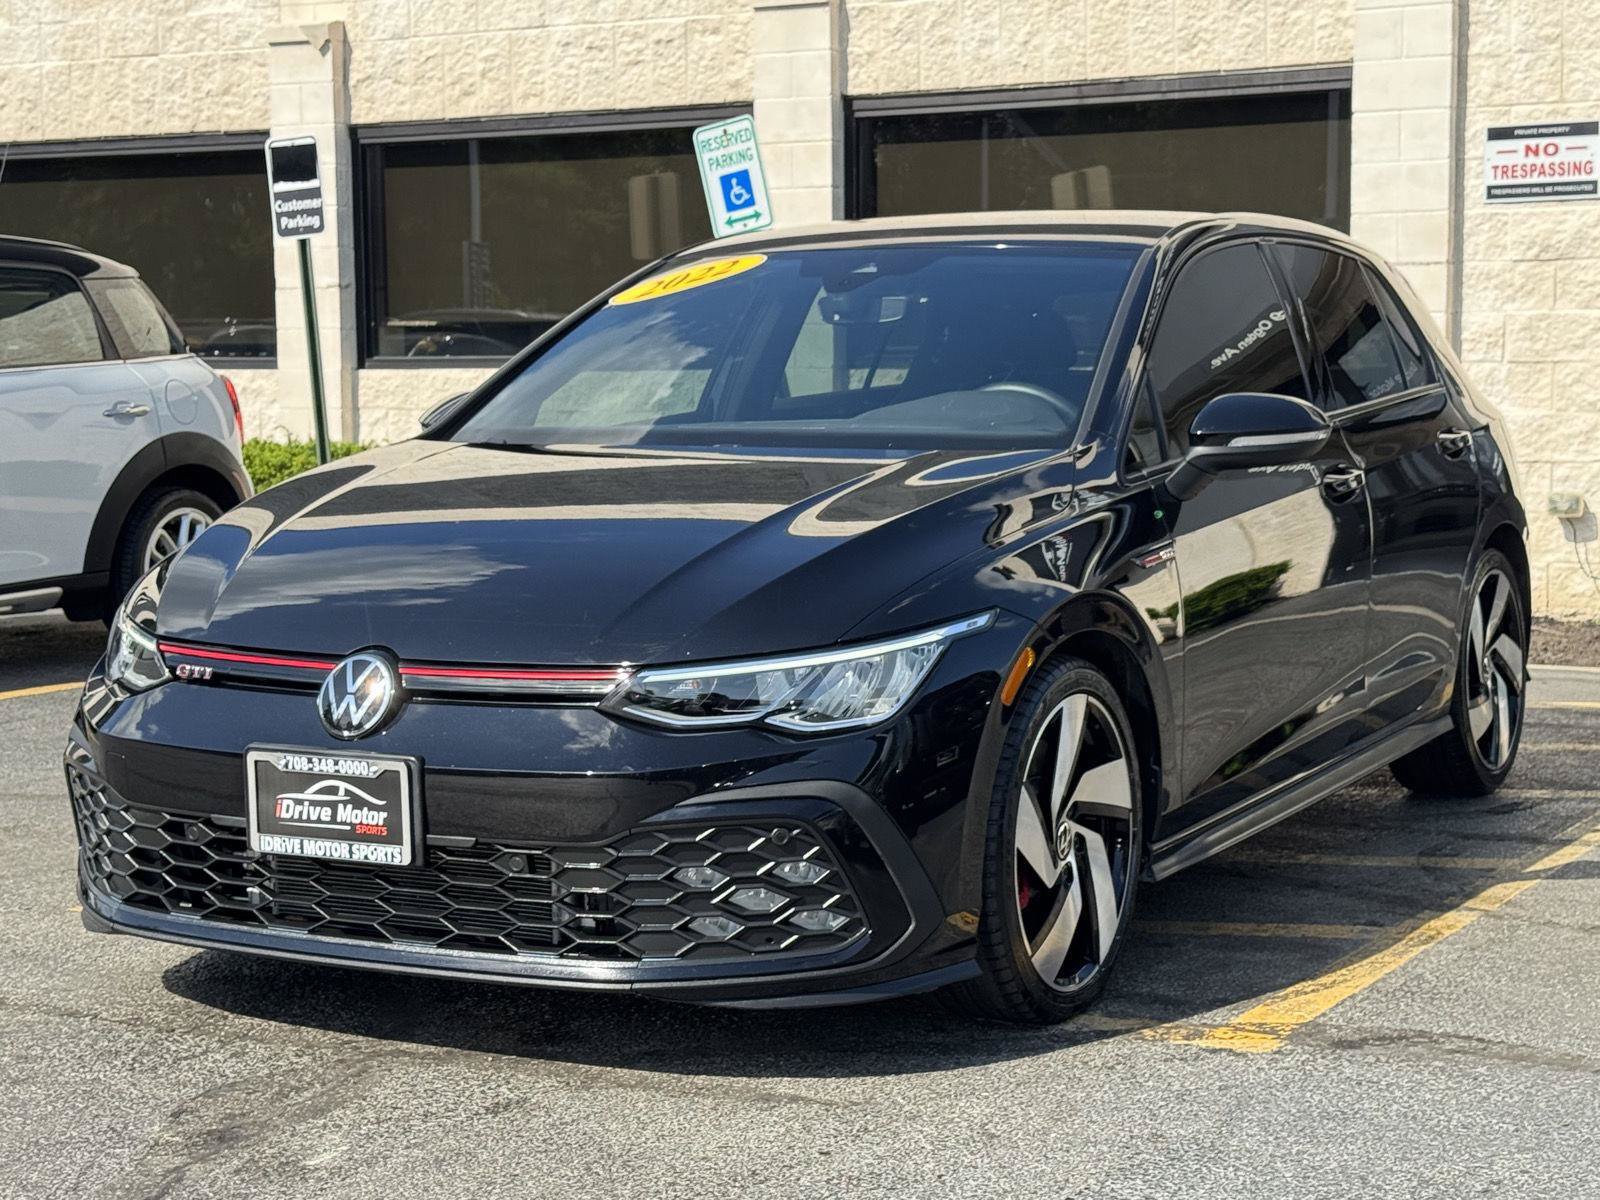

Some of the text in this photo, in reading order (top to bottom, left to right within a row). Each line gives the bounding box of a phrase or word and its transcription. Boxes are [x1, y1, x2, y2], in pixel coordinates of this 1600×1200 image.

[700, 128, 753, 153] RESERVED
[1524, 143, 1559, 158] NO
[707, 147, 754, 172] PARKING
[1491, 160, 1594, 180] TRESPASSING
[274, 197, 322, 213] Customer
[280, 213, 321, 231] Parking
[634, 259, 741, 299] 2022
[175, 663, 214, 681] GTI
[285, 754, 369, 776] 708-348-0000
[274, 797, 388, 826] iDrive Motor
[355, 824, 388, 836] SPORTS
[302, 839, 351, 859] MOTOR
[351, 844, 402, 864] SPORTS
